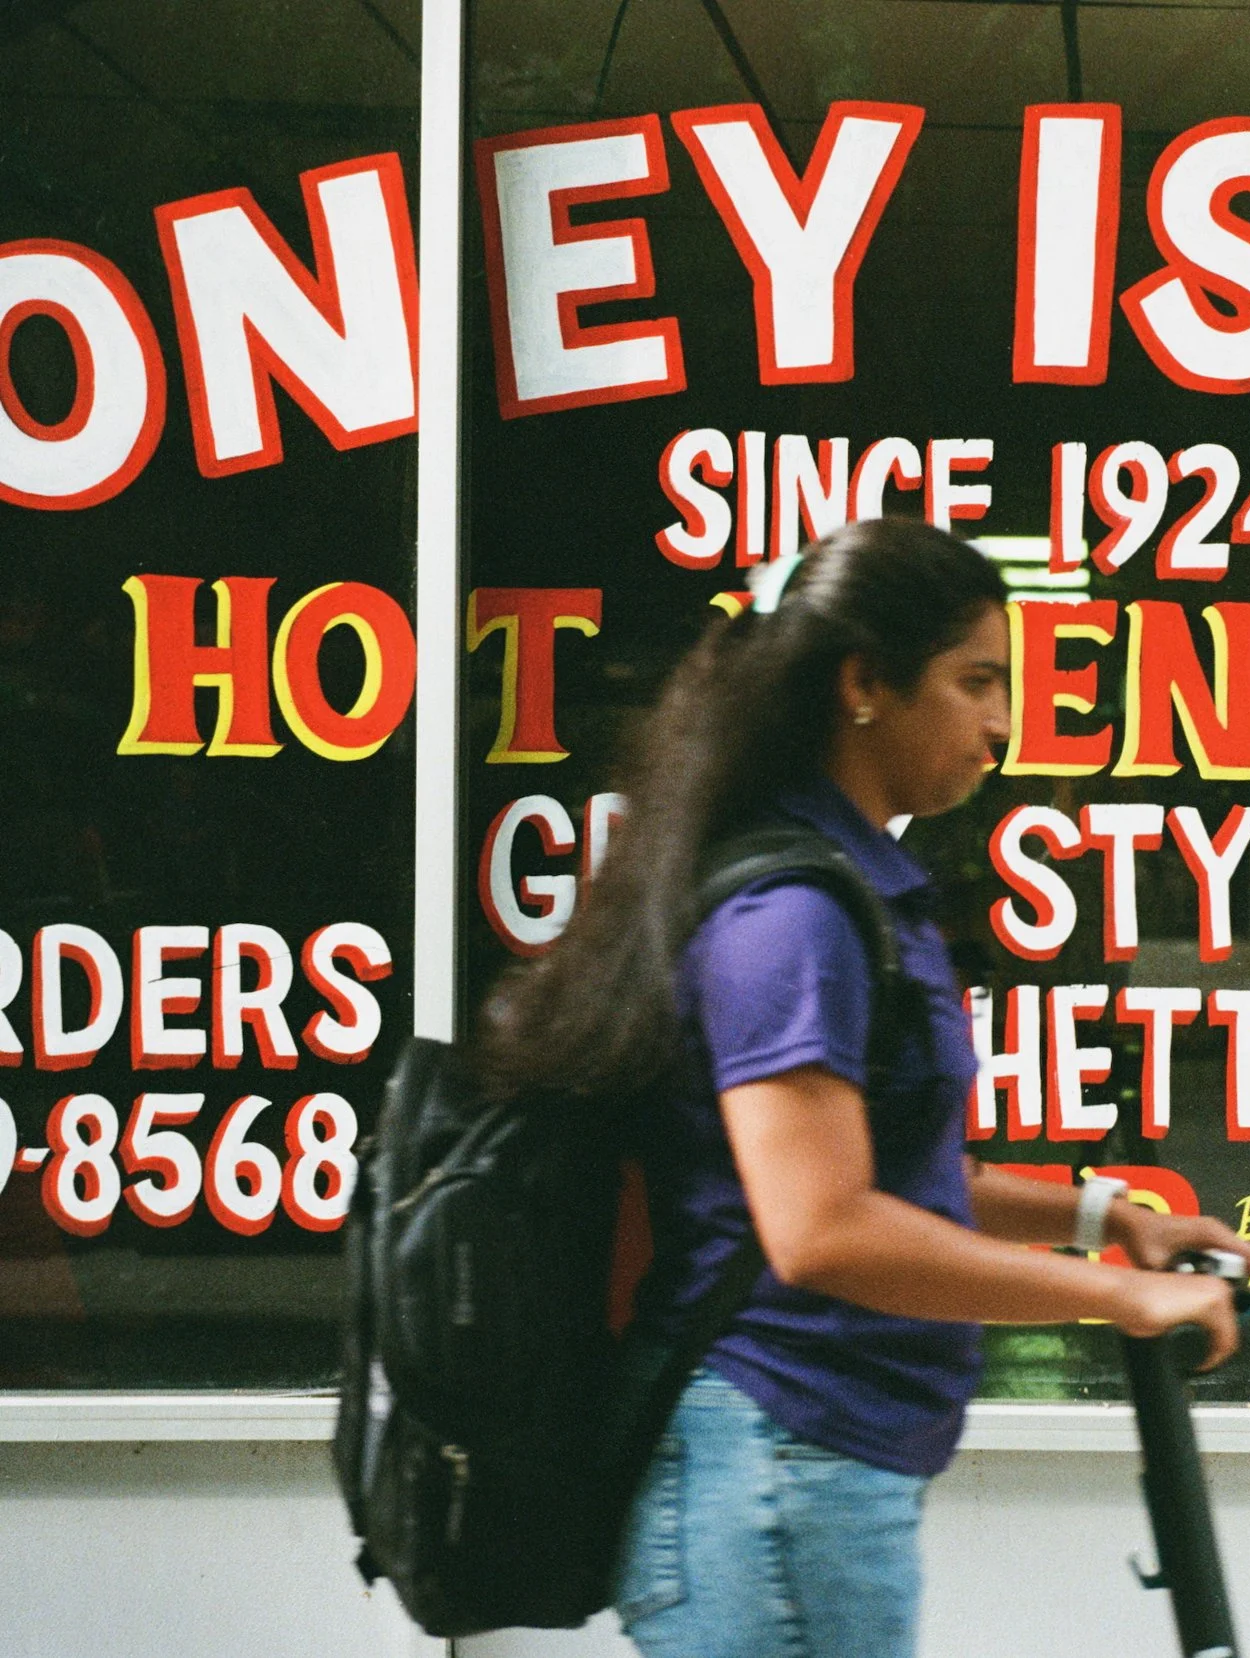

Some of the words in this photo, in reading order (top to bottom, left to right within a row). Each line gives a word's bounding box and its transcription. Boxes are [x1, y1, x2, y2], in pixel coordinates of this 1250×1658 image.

[655, 428, 994, 571] SINCE
[116, 573, 603, 765] HOT
[0, 922, 393, 1072] DERS
[0, 1091, 359, 1238] -8568
